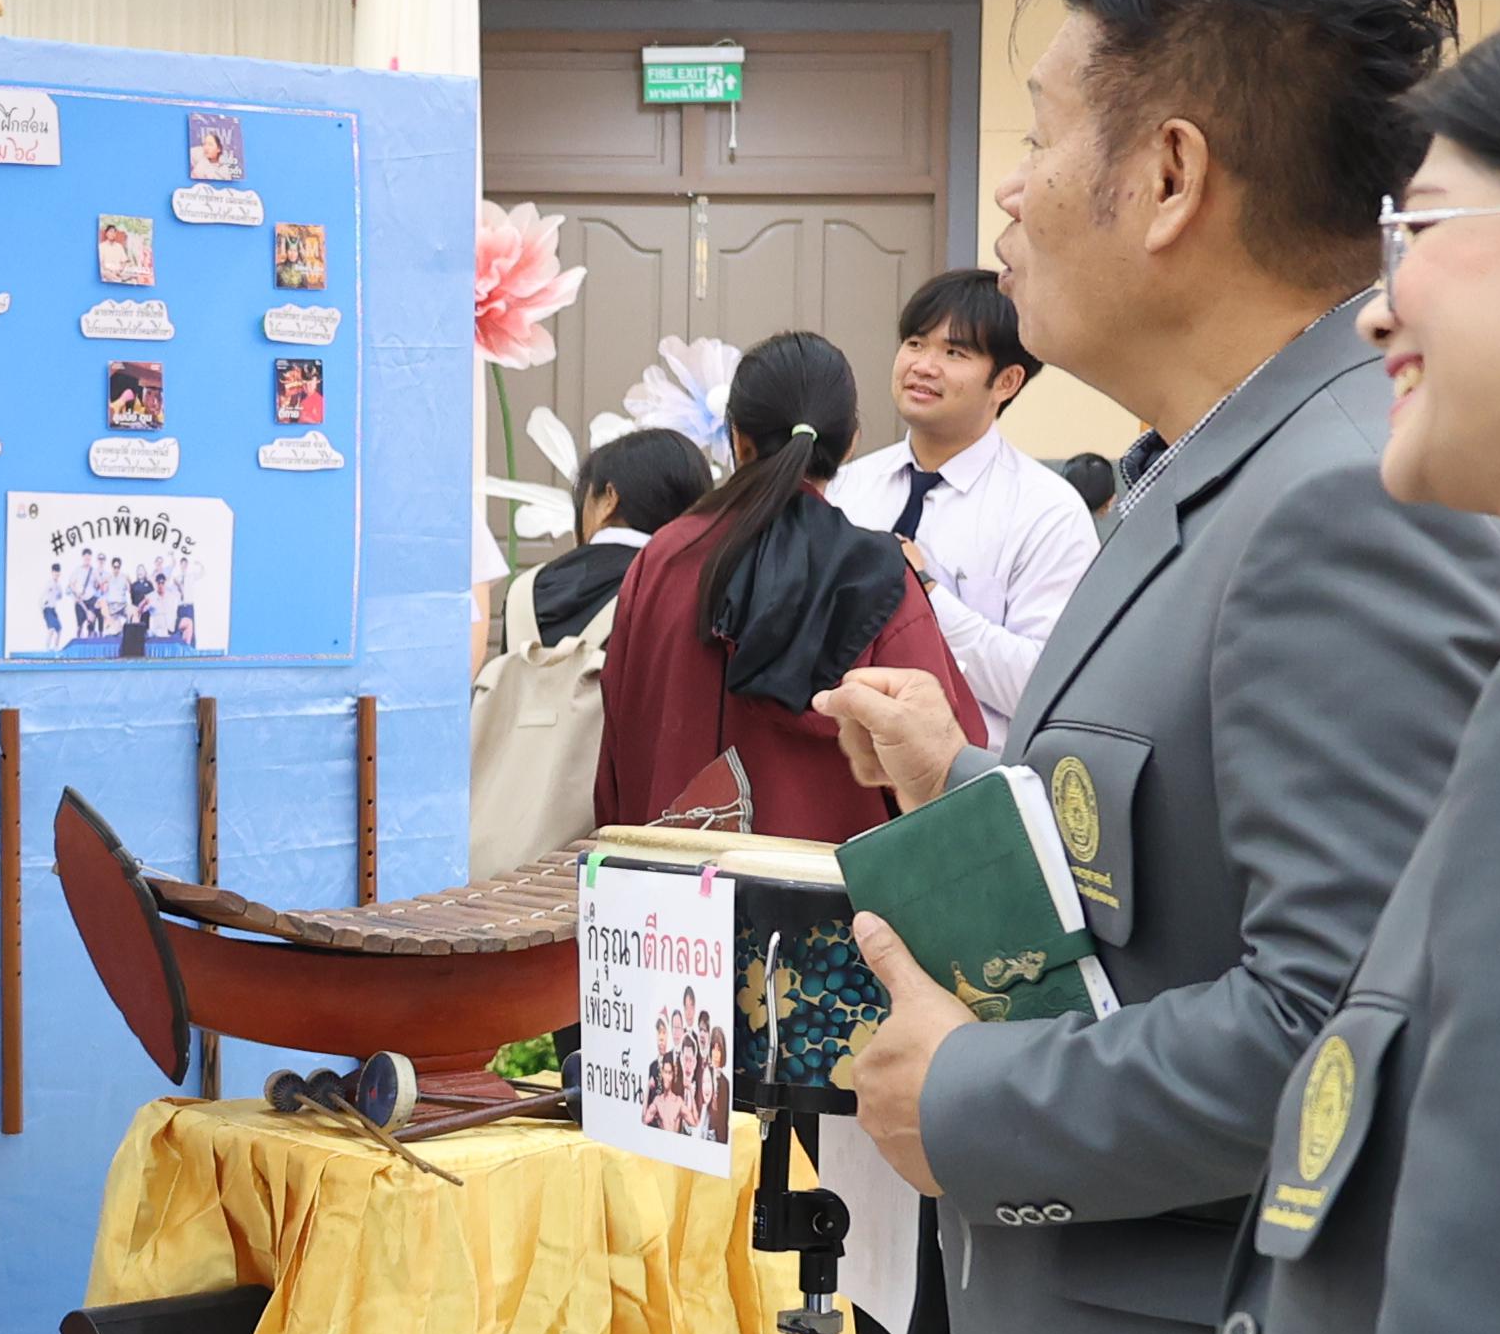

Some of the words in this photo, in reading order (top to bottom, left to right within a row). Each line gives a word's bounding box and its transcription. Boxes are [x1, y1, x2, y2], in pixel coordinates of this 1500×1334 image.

[647, 67, 675, 79] FIRE
[677, 67, 706, 79] EXIT
[50, 505, 196, 556] #ตากพิทดิวะ
[584, 967, 634, 1034] เพื่อรับ
[585, 1048, 644, 1105] ลายเซ็น
